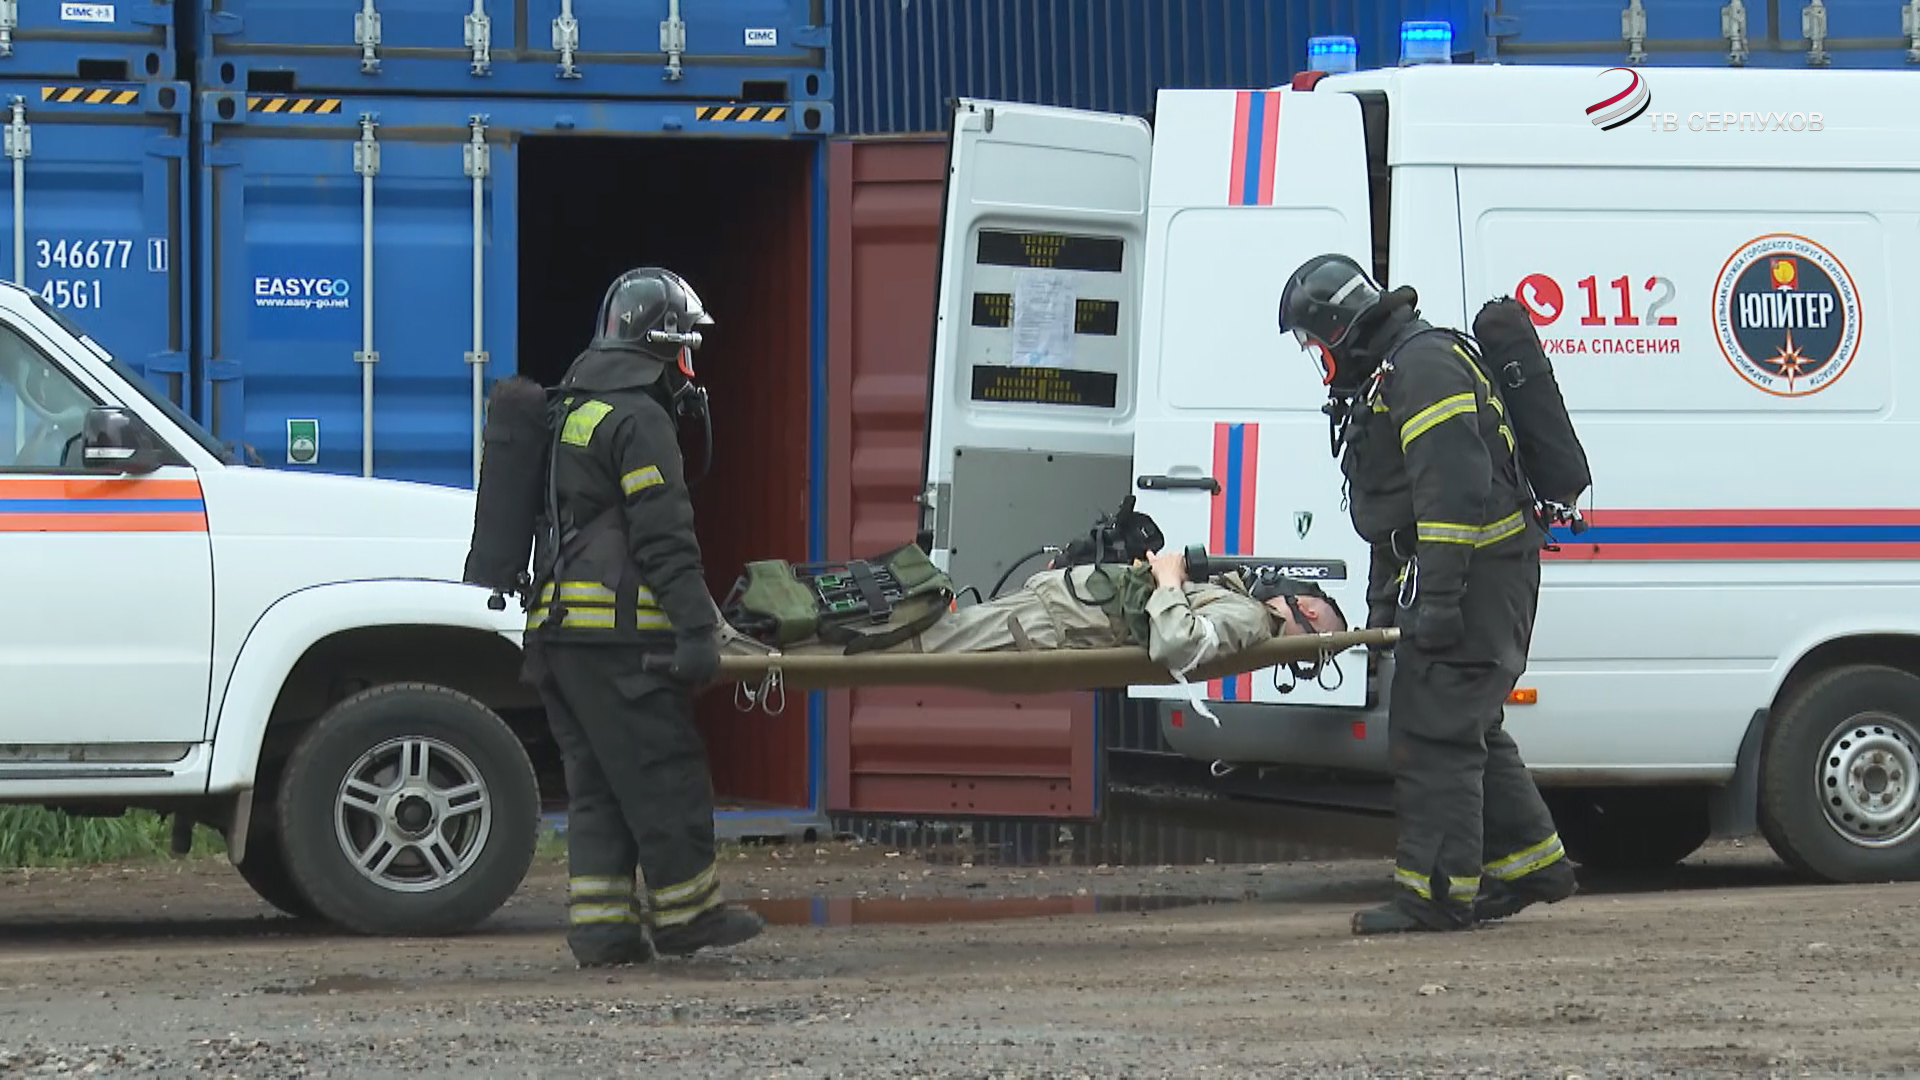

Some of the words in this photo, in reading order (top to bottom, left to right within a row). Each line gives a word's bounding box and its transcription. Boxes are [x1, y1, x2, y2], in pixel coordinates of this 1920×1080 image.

[65, 7, 93, 18] CIMC
[748, 31, 774, 40] CIMC
[36, 239, 133, 269] 346677
[41, 279, 101, 309] 45G1
[255, 277, 350, 296] EASYGO
[256, 298, 349, 310] www.easy-go.net
[1577, 275, 1678, 326] 112
[1739, 292, 1834, 328] ЮПИТЕР
[1592, 339, 1680, 354] СПАСЕНИЯ
